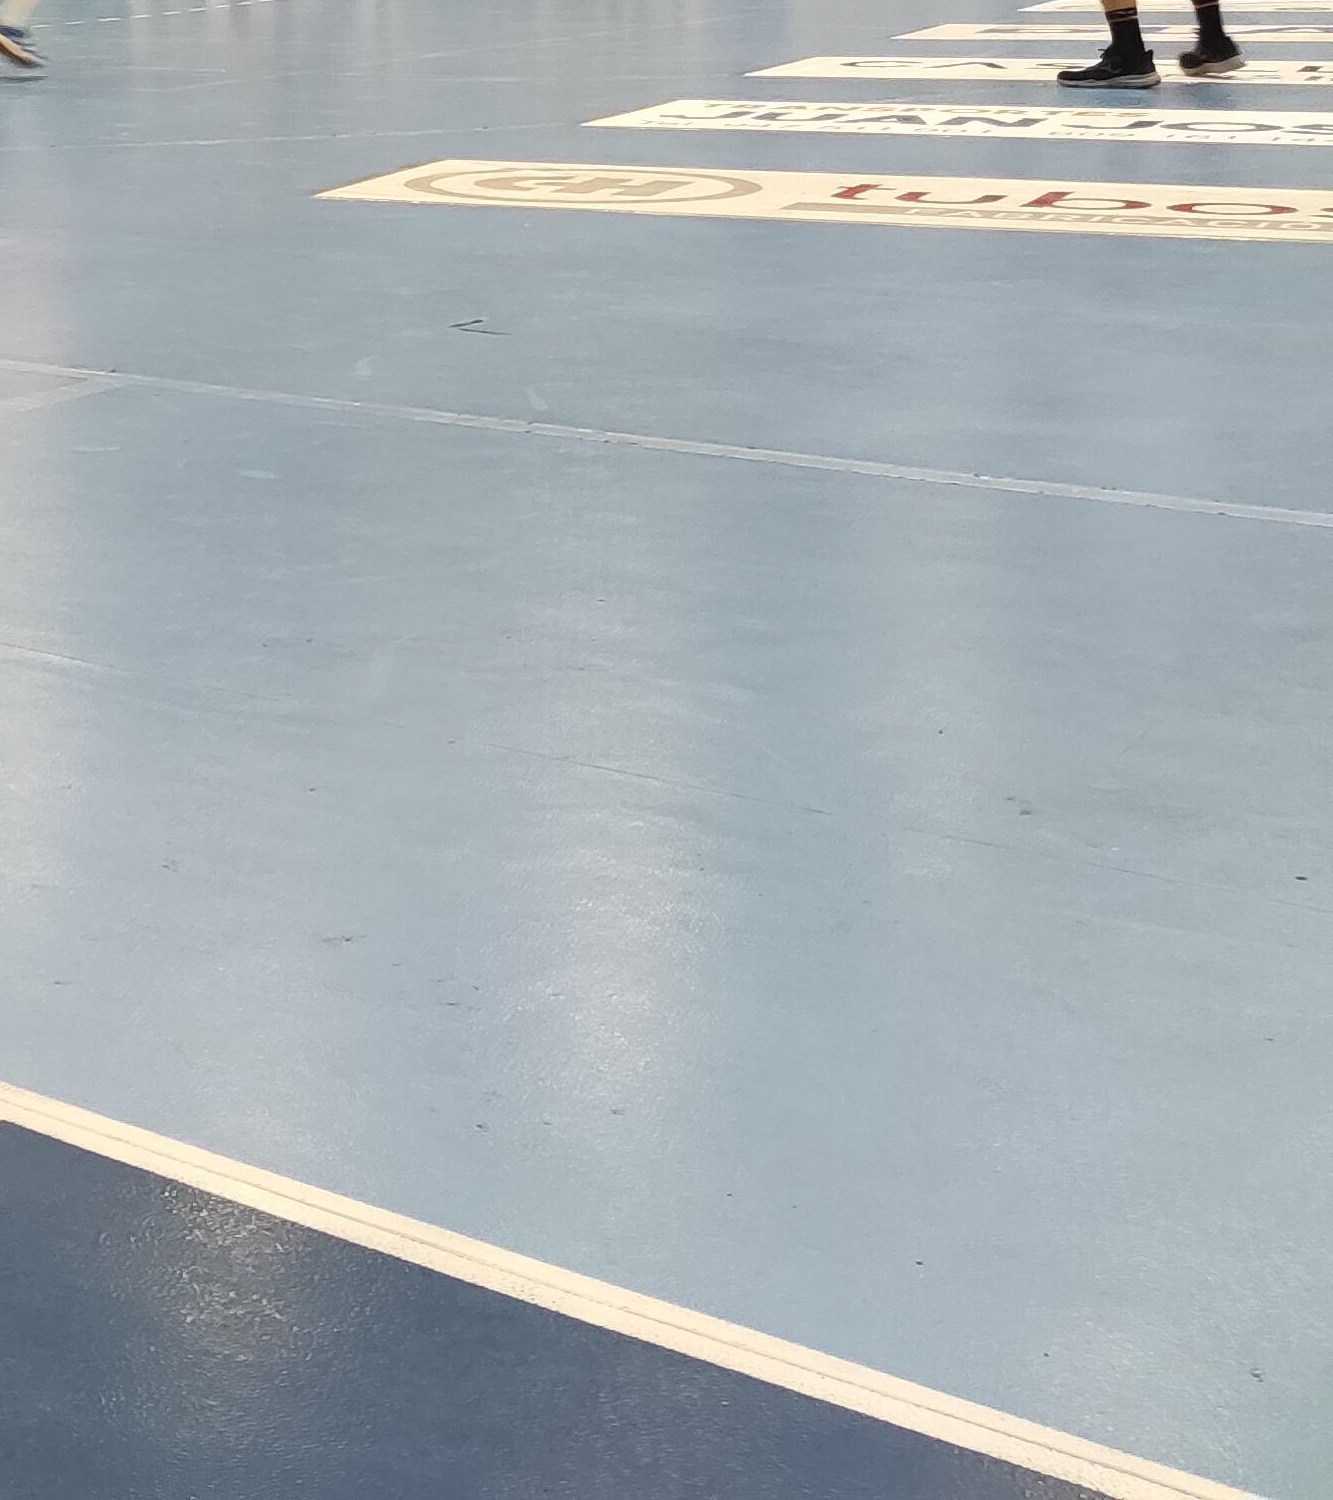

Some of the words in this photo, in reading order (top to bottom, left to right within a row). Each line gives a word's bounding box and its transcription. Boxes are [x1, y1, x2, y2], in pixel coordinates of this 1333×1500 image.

[659, 110, 1050, 128] JUAN
[703, 102, 1151, 118] TRANSPORTES
[904, 207, 1333, 233] FABRICACIO
